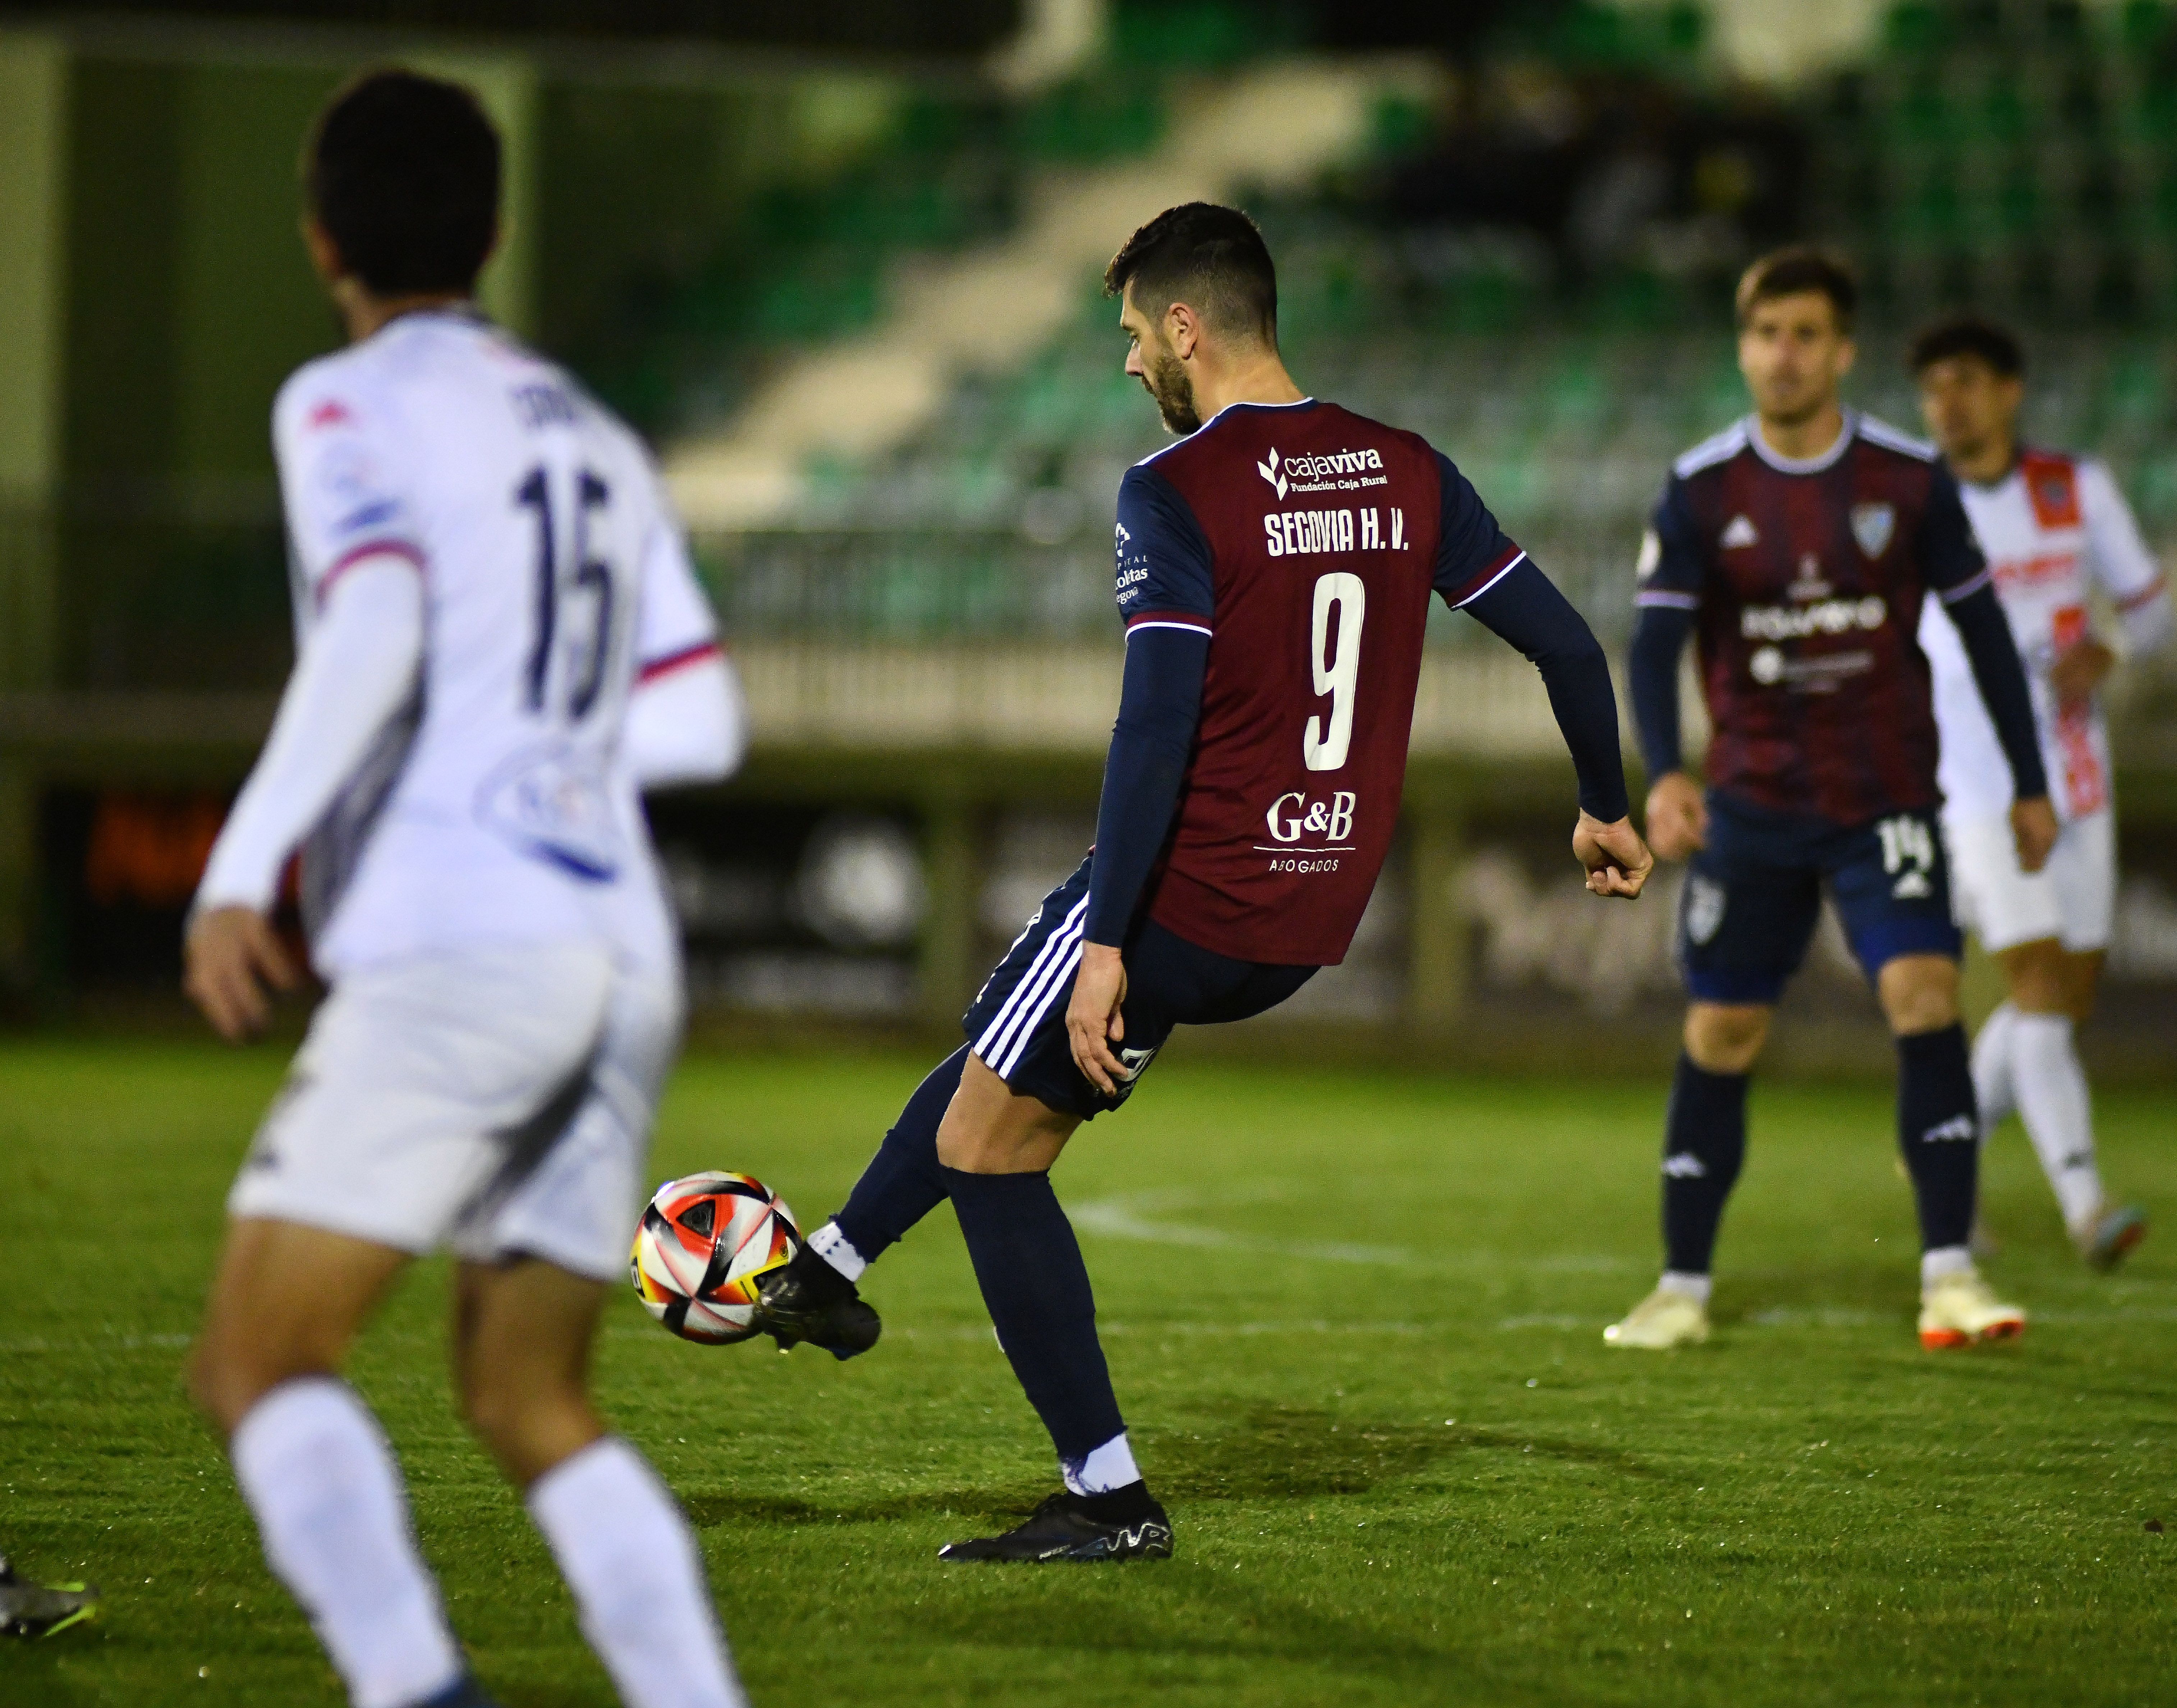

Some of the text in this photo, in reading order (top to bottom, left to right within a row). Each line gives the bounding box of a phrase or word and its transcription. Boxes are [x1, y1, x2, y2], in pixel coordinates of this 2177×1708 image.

[1284, 448, 1383, 482] cajaviva
[1290, 475, 1388, 492] Fundación Caja Rural
[1264, 507, 1409, 557] SEGOVIA H. V.
[1115, 555, 1148, 570] PITAL
[514, 466, 611, 719] 15
[1303, 572, 1366, 771] 9
[1267, 791, 1356, 842] G&B
[1269, 859, 1338, 873] ABOGADOS
